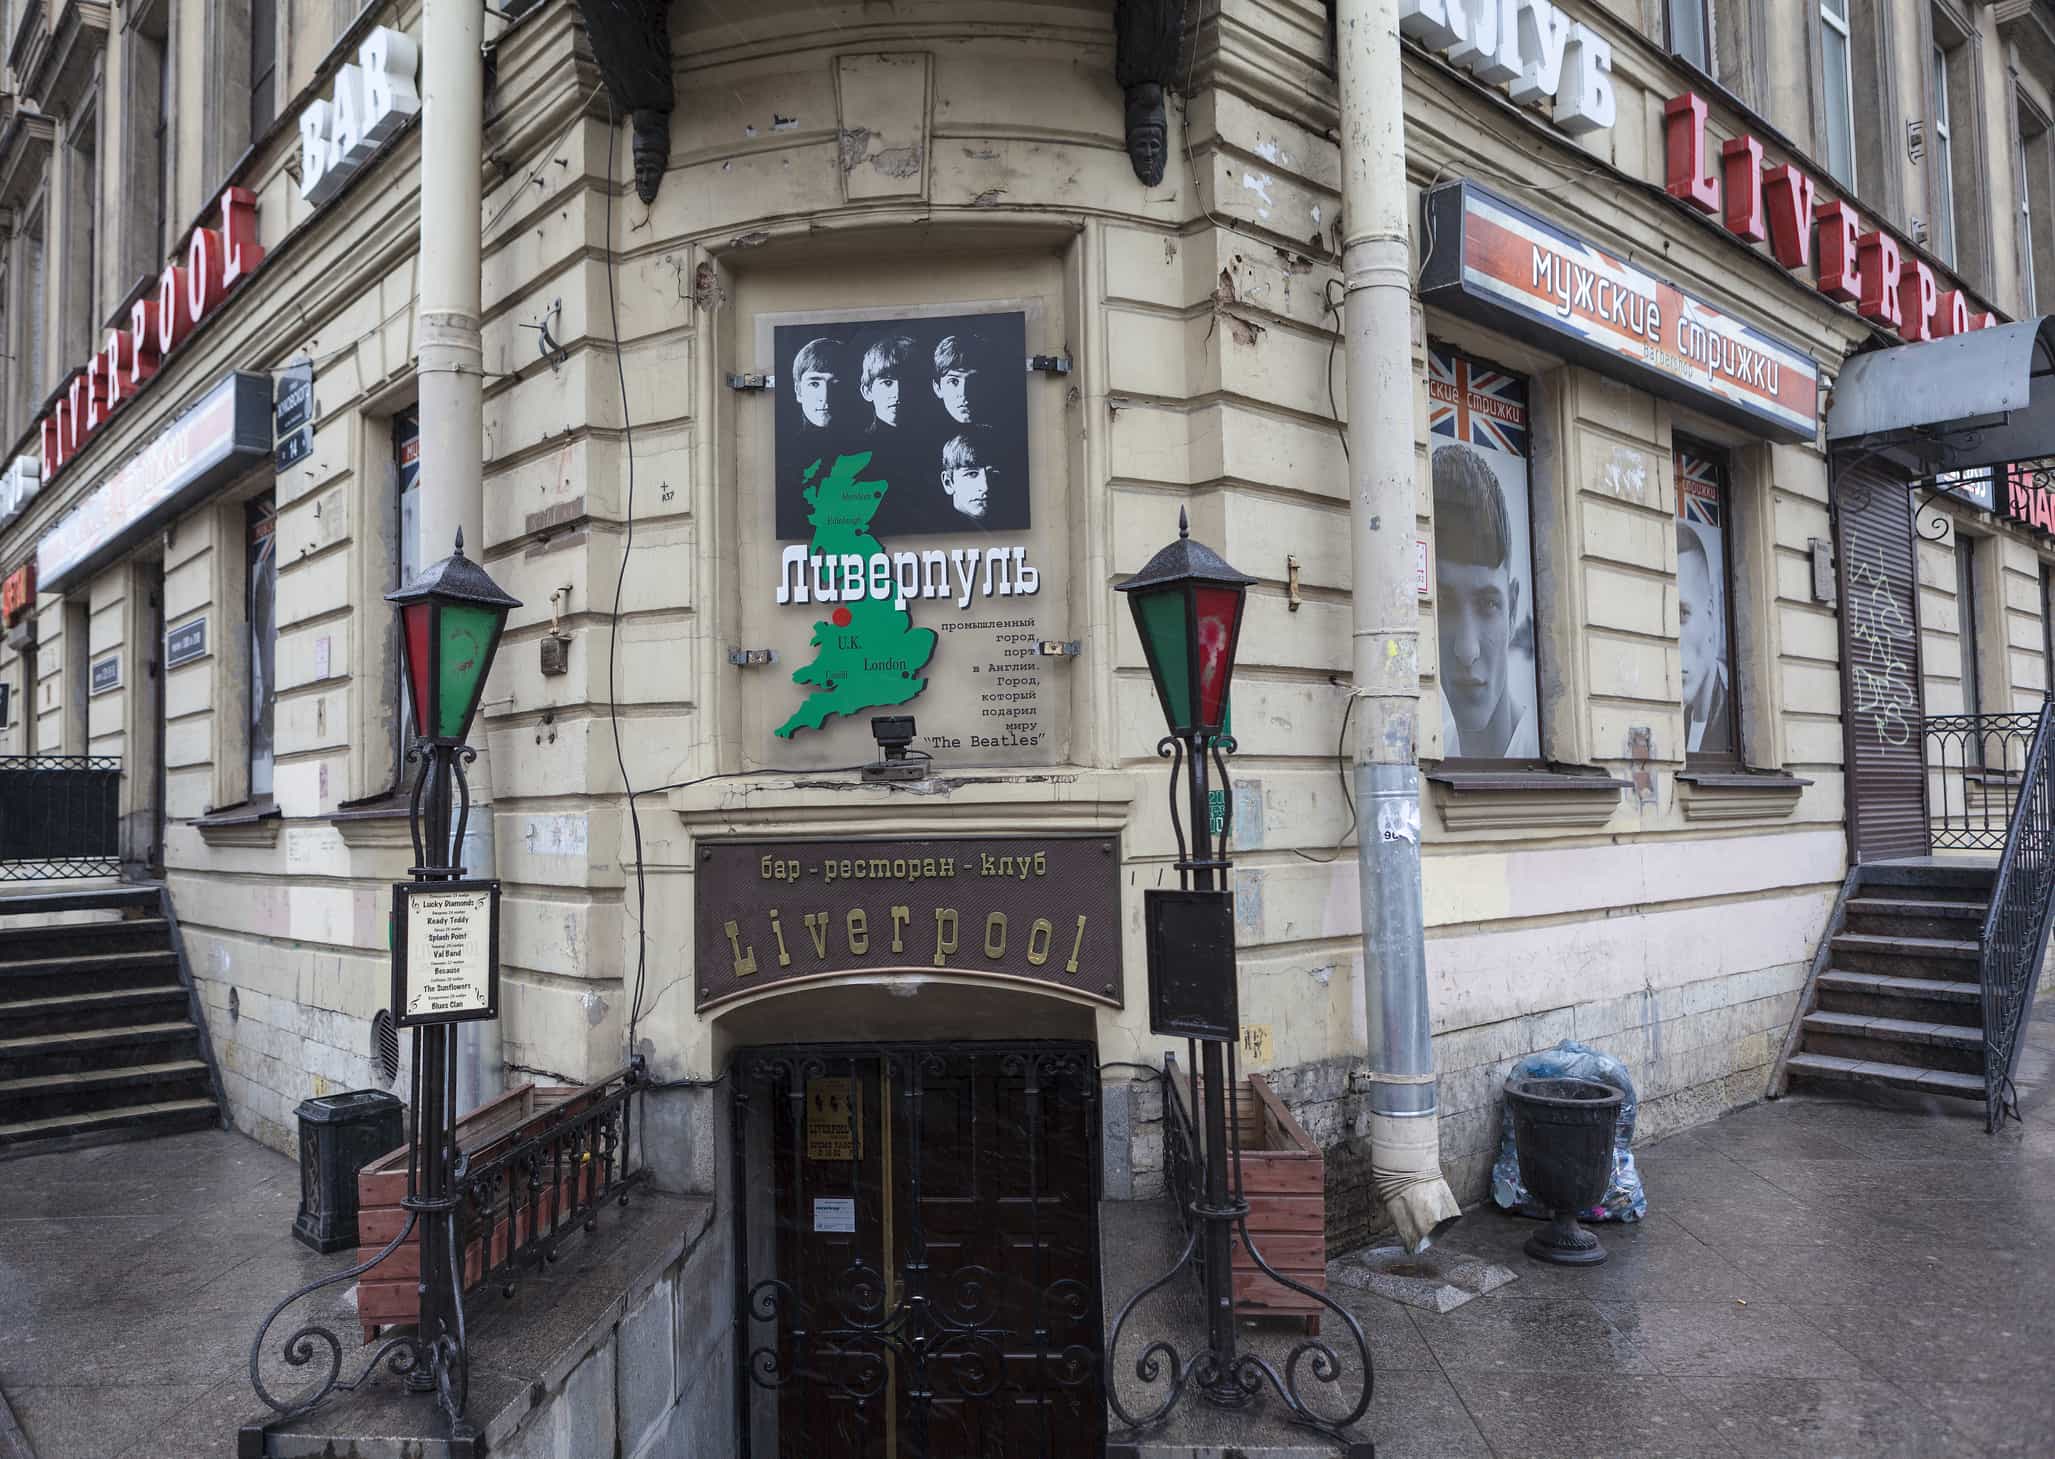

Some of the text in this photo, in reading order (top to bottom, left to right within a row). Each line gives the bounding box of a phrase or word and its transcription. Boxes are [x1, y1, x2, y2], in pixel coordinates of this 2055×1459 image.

[300, 25, 418, 204] BAR
[1666, 91, 1997, 342] LIVERPO
[41, 187, 264, 485] LIVERPOOL
[1677, 316, 1779, 396] стрижки
[1430, 380, 1520, 423] ские стрижки
[776, 544, 1041, 610] Ливерпуль
[941, 617, 1035, 632] промышленный
[863, 657, 906, 671] London
[988, 662, 1040, 673] Англии.
[997, 676, 1040, 687] Город,
[981, 690, 1037, 702] который
[982, 707, 1037, 718] подарил
[1005, 722, 1038, 733] миру
[760, 854, 801, 884] бар
[824, 855, 956, 883] ресторан
[980, 850, 1048, 880] клуб
[423, 898, 475, 909] Lucky Diamonds
[427, 916, 469, 926] Ready Teddy
[428, 932, 467, 943] Splash Point
[724, 904, 1088, 977] Liverpool
[433, 950, 462, 959] Val Band
[424, 983, 472, 993] The Sunflowers
[432, 1002, 449, 1010] Blues
